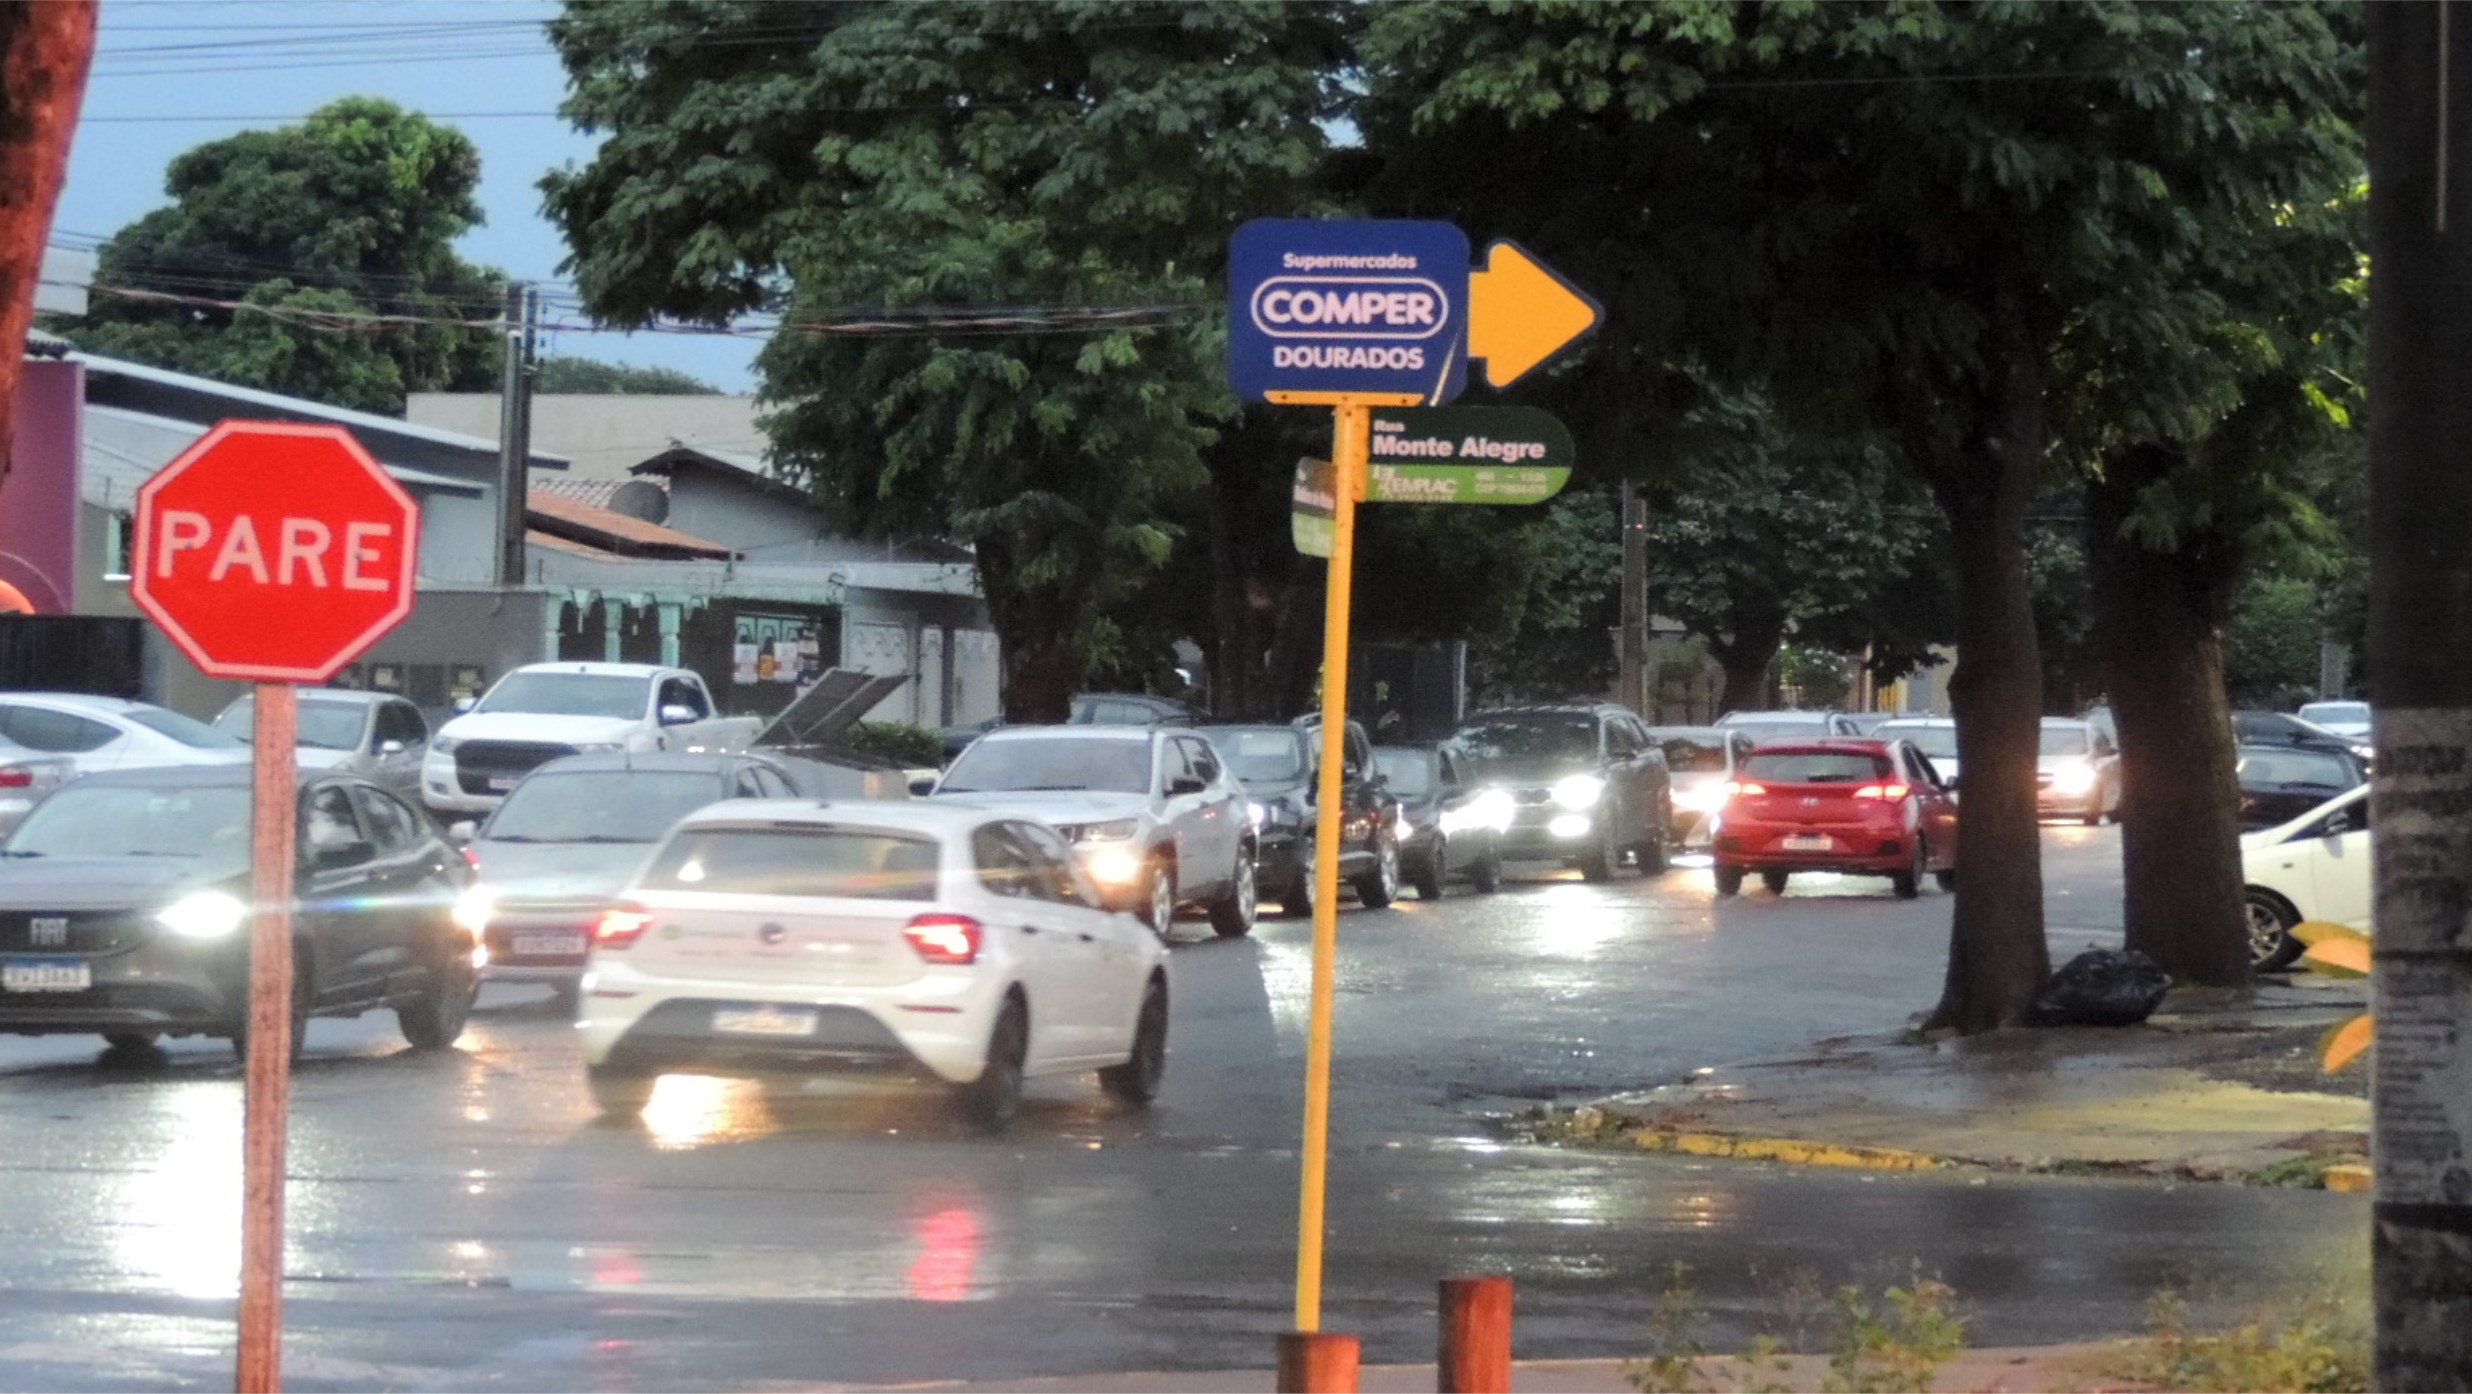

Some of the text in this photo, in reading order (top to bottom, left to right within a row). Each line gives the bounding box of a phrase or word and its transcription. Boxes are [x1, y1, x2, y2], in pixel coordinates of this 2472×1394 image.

[1283, 252, 1417, 271] Supermercados
[1263, 290, 1435, 325] COMPER
[1273, 346, 1424, 370] DOURADOS
[1374, 420, 1405, 432] Rua
[1373, 435, 1546, 463] Monte Alegre
[157, 509, 393, 592] PARE
[30, 917, 69, 945] FIAT
